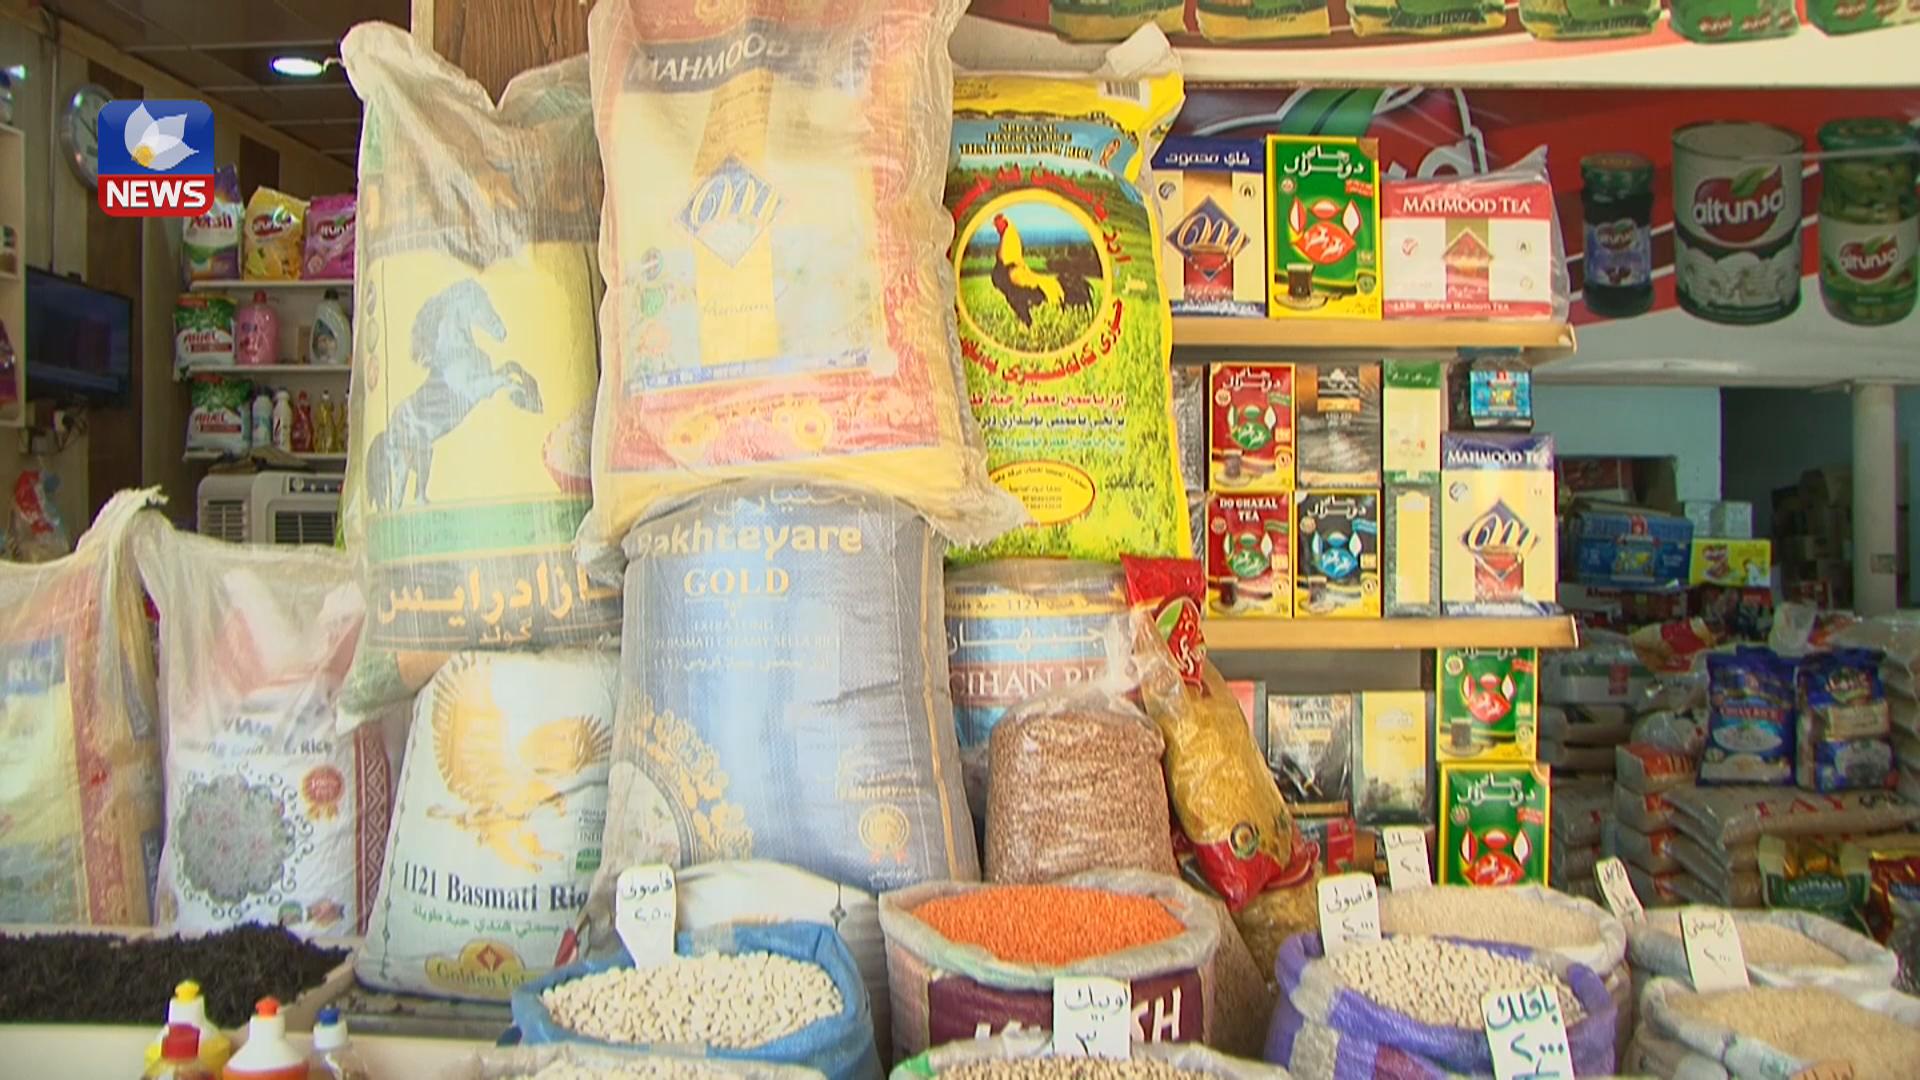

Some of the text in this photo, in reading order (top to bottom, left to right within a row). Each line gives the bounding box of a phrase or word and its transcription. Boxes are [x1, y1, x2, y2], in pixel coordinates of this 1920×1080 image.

[1402, 197, 1531, 214] MAHMOOD TEA
[1448, 450, 1522, 464] MAHMOOD
[1236, 497, 1278, 509] GHAZAL
[1239, 509, 1260, 522] TEA
[683, 568, 790, 595] GOLD
[403, 861, 589, 912] 1121 Basmati Ric
